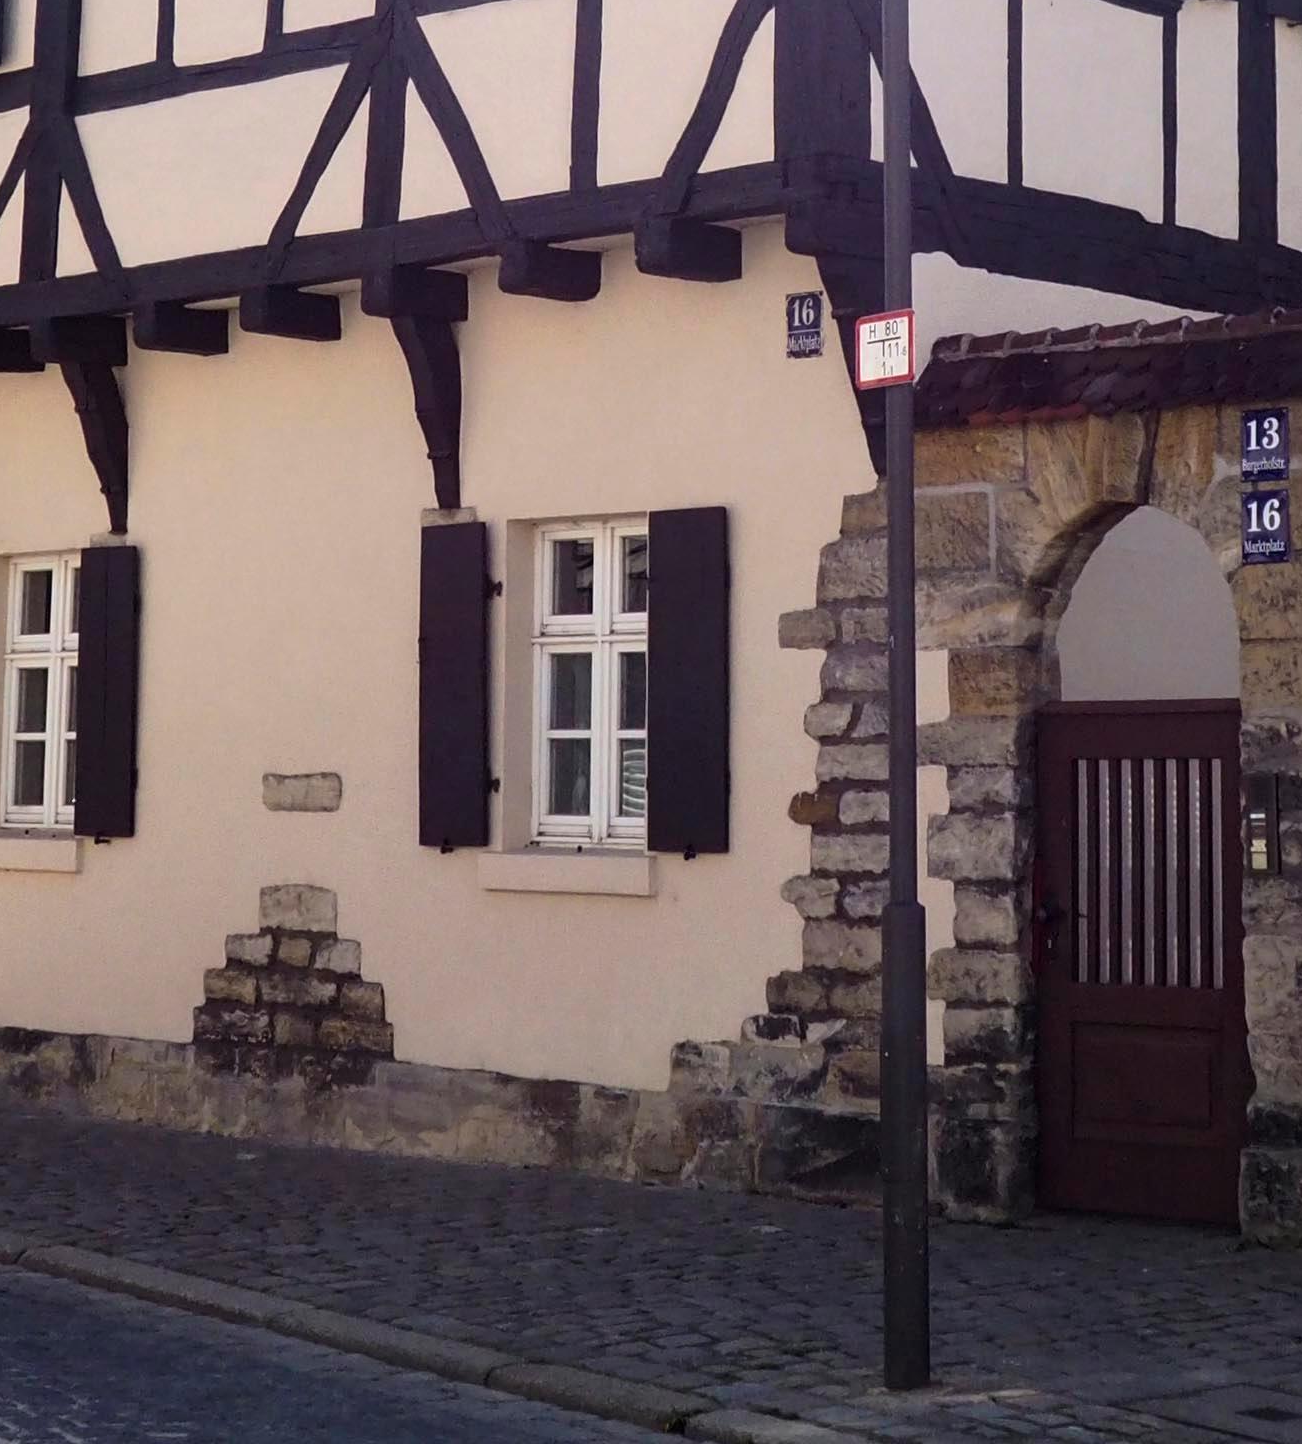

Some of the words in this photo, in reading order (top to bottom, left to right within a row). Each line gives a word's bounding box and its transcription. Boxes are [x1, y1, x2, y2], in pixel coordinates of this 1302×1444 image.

[792, 298, 815, 326] 16
[869, 323, 877, 339] H
[884, 320, 898, 336] 80
[1246, 417, 1280, 450] 13
[1247, 499, 1281, 532] 16
[1244, 538, 1285, 556] Marktplatz
